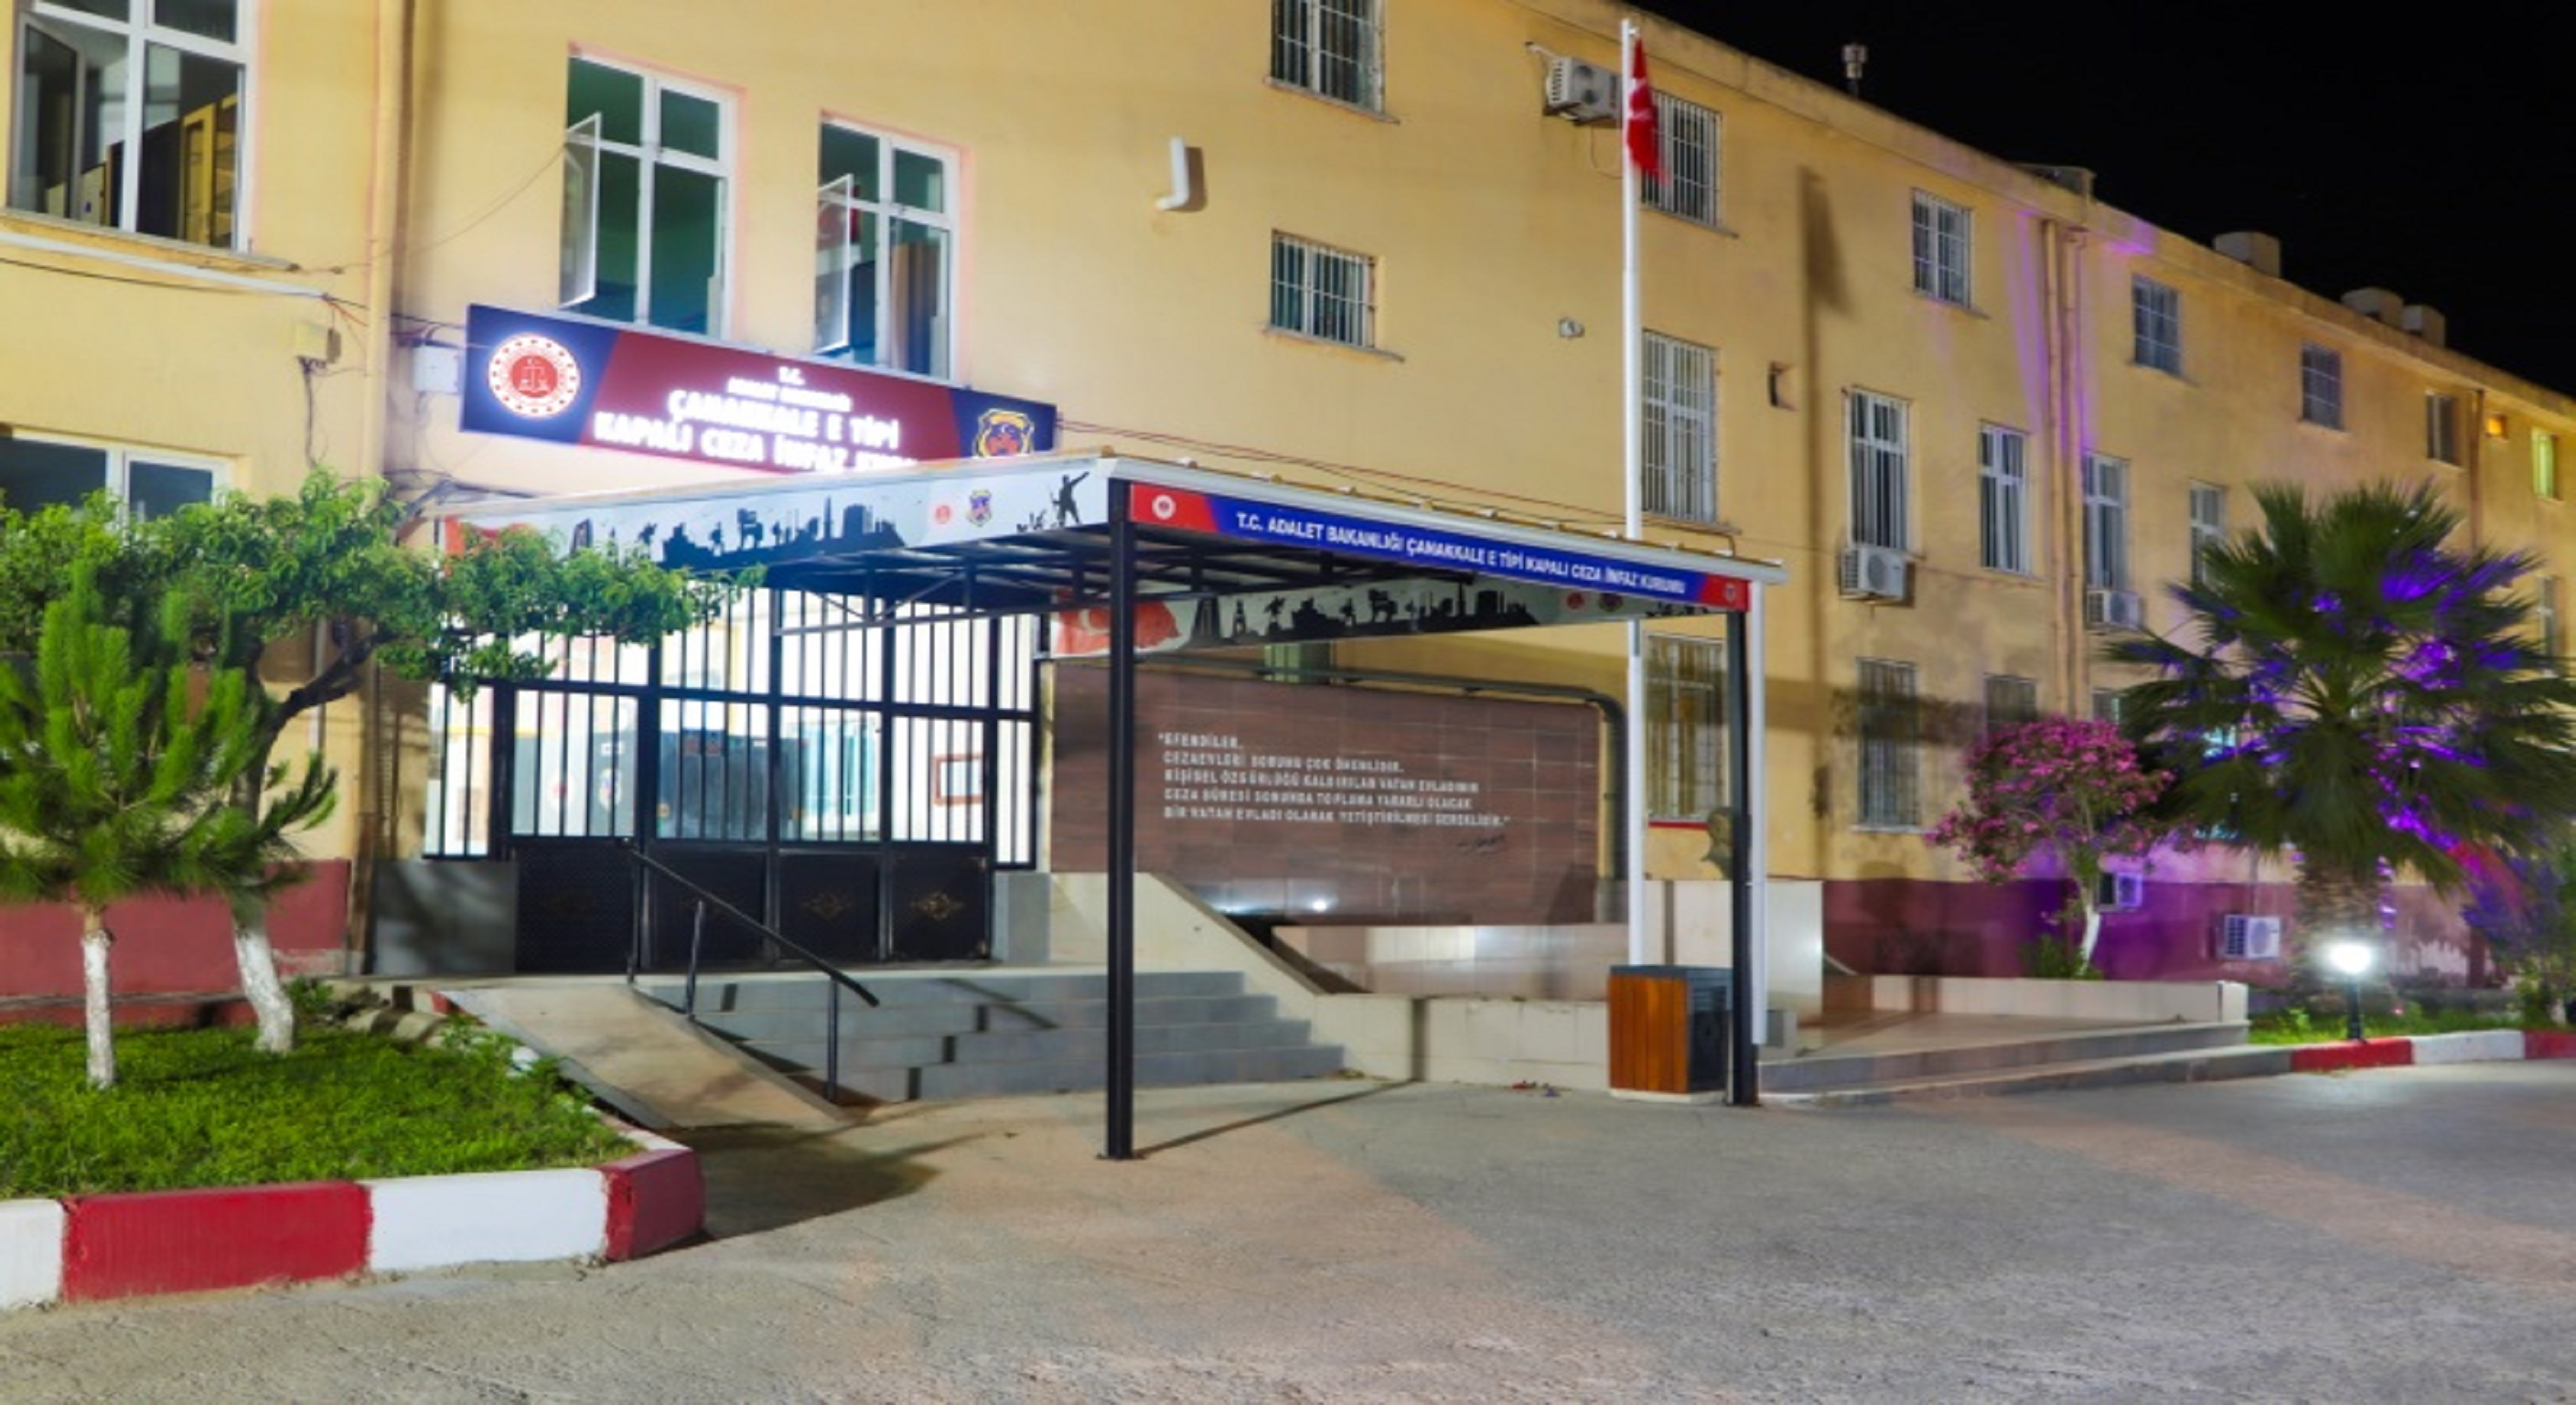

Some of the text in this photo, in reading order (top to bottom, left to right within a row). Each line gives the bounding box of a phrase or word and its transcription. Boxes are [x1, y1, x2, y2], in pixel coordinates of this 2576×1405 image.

[595, 412, 692, 451] KAPALI
[701, 429, 763, 461] CEZA
[668, 390, 818, 437] ÇANAKKALE
[827, 414, 842, 441] E
[851, 416, 899, 449] TİPİ
[1237, 512, 1686, 594] T.C. ADALET BAKANLIĞI ÇANAKKALE E TİPİ KAPALI CEZA İNFAZ KURUMU
[1165, 788, 1197, 800] CEZA
